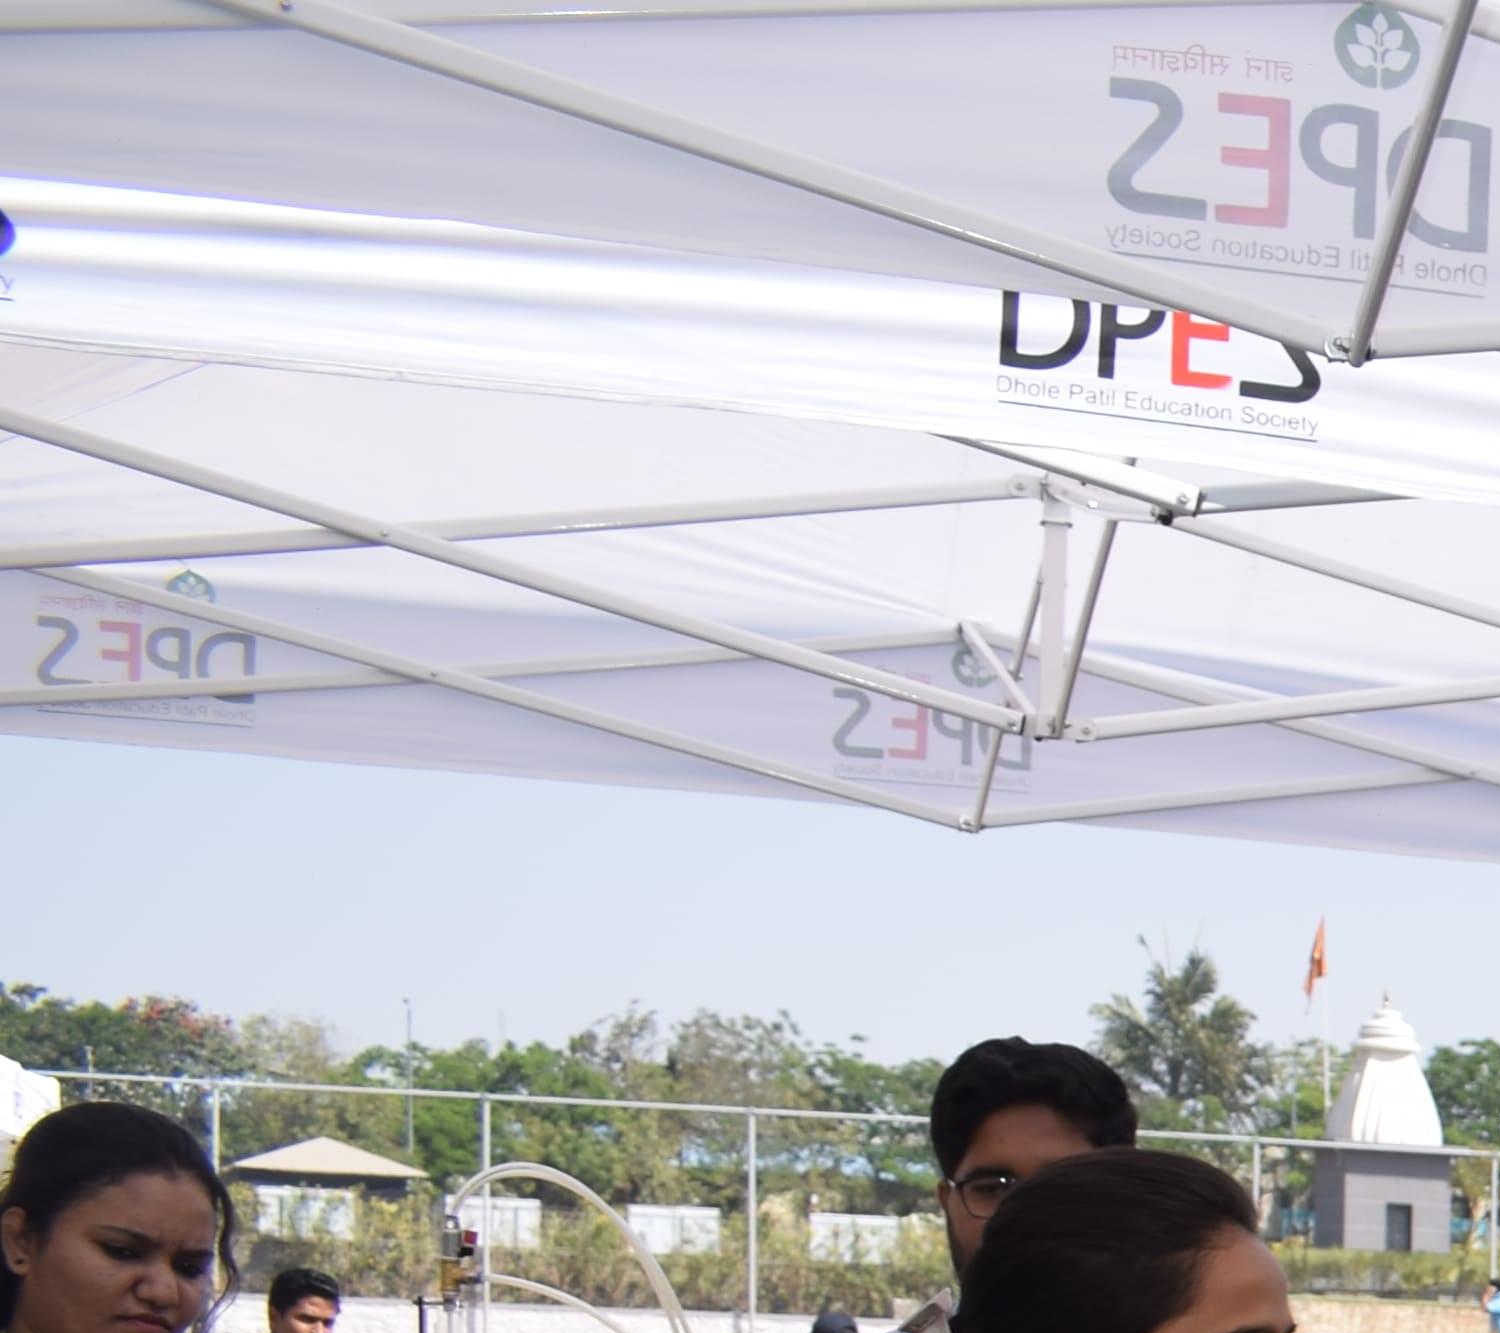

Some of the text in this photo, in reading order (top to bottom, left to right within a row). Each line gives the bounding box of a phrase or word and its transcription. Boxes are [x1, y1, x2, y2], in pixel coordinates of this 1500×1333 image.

[1000, 290, 1321, 403] DPES
[996, 374, 1318, 436] Dhole Patil Education Society
